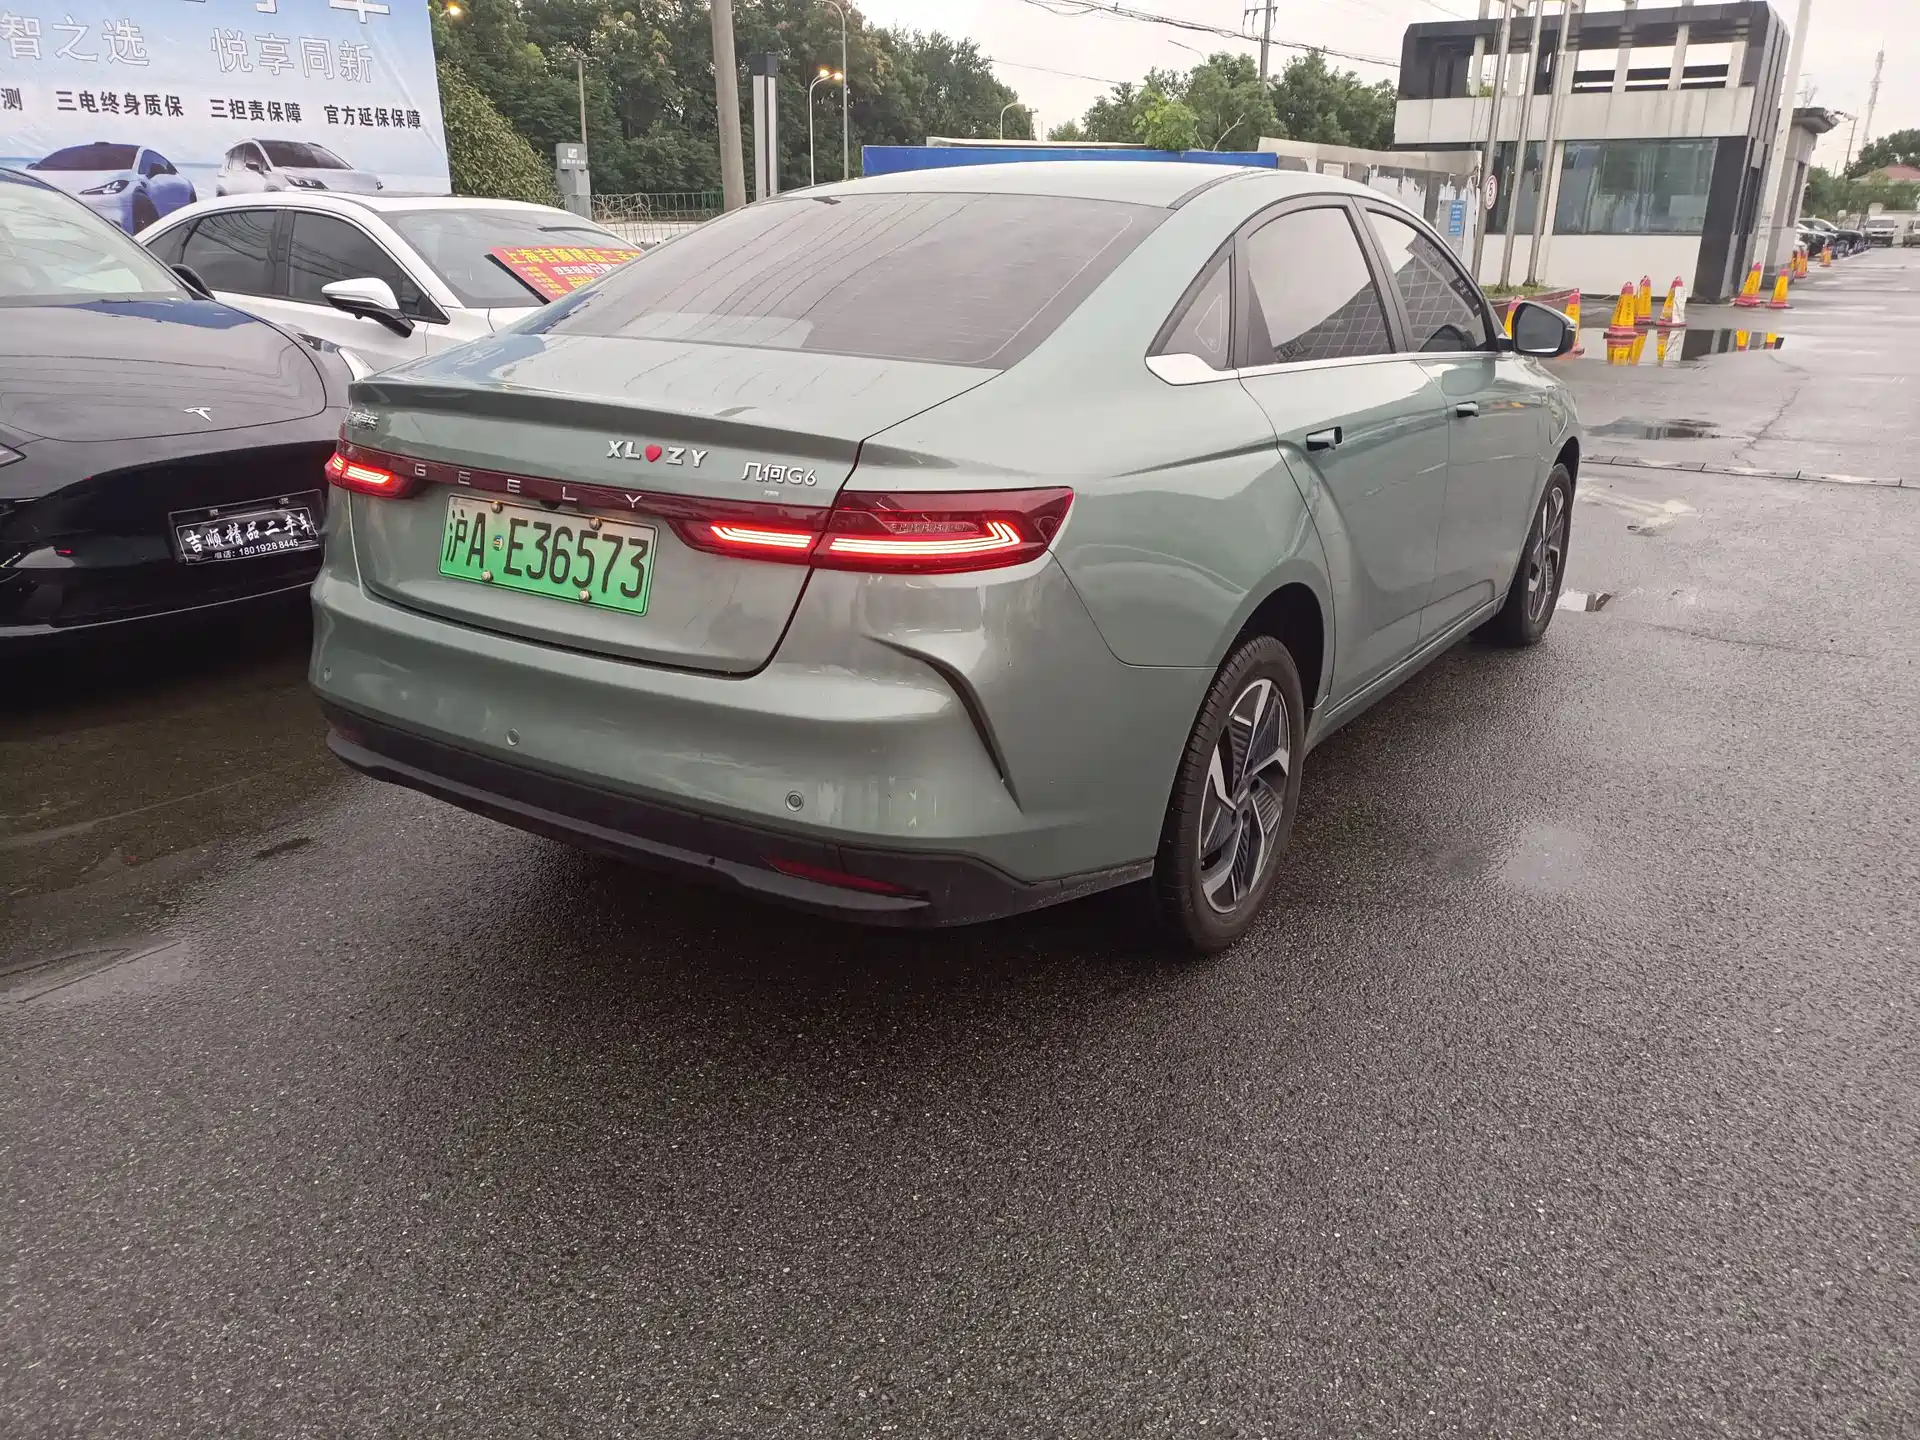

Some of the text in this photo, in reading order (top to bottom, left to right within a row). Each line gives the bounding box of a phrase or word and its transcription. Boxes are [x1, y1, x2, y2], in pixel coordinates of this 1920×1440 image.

[211, 28, 373, 83] 悦享同新
[55, 90, 184, 117] 三电终身质保
[210, 99, 302, 123] 三担责保障
[323, 104, 421, 129] 官方延保保障
[414, 463, 642, 509] GEELY
